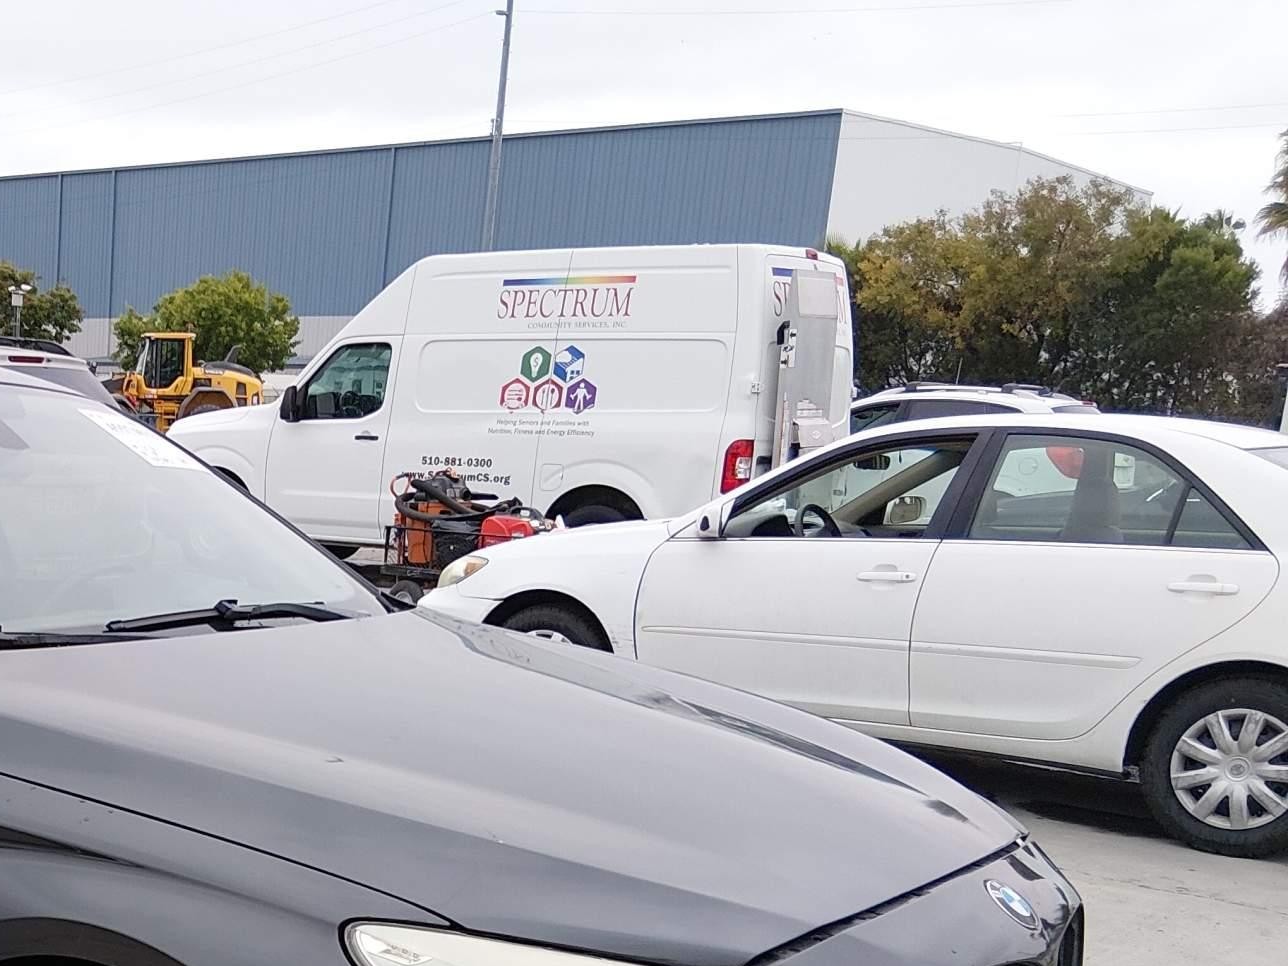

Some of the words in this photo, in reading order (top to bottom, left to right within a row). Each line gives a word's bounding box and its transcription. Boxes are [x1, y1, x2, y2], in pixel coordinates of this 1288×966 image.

[497, 287, 634, 319] SPECTRUM
[546, 429, 565, 437] Energy
[421, 456, 493, 468] 510-881-0300
